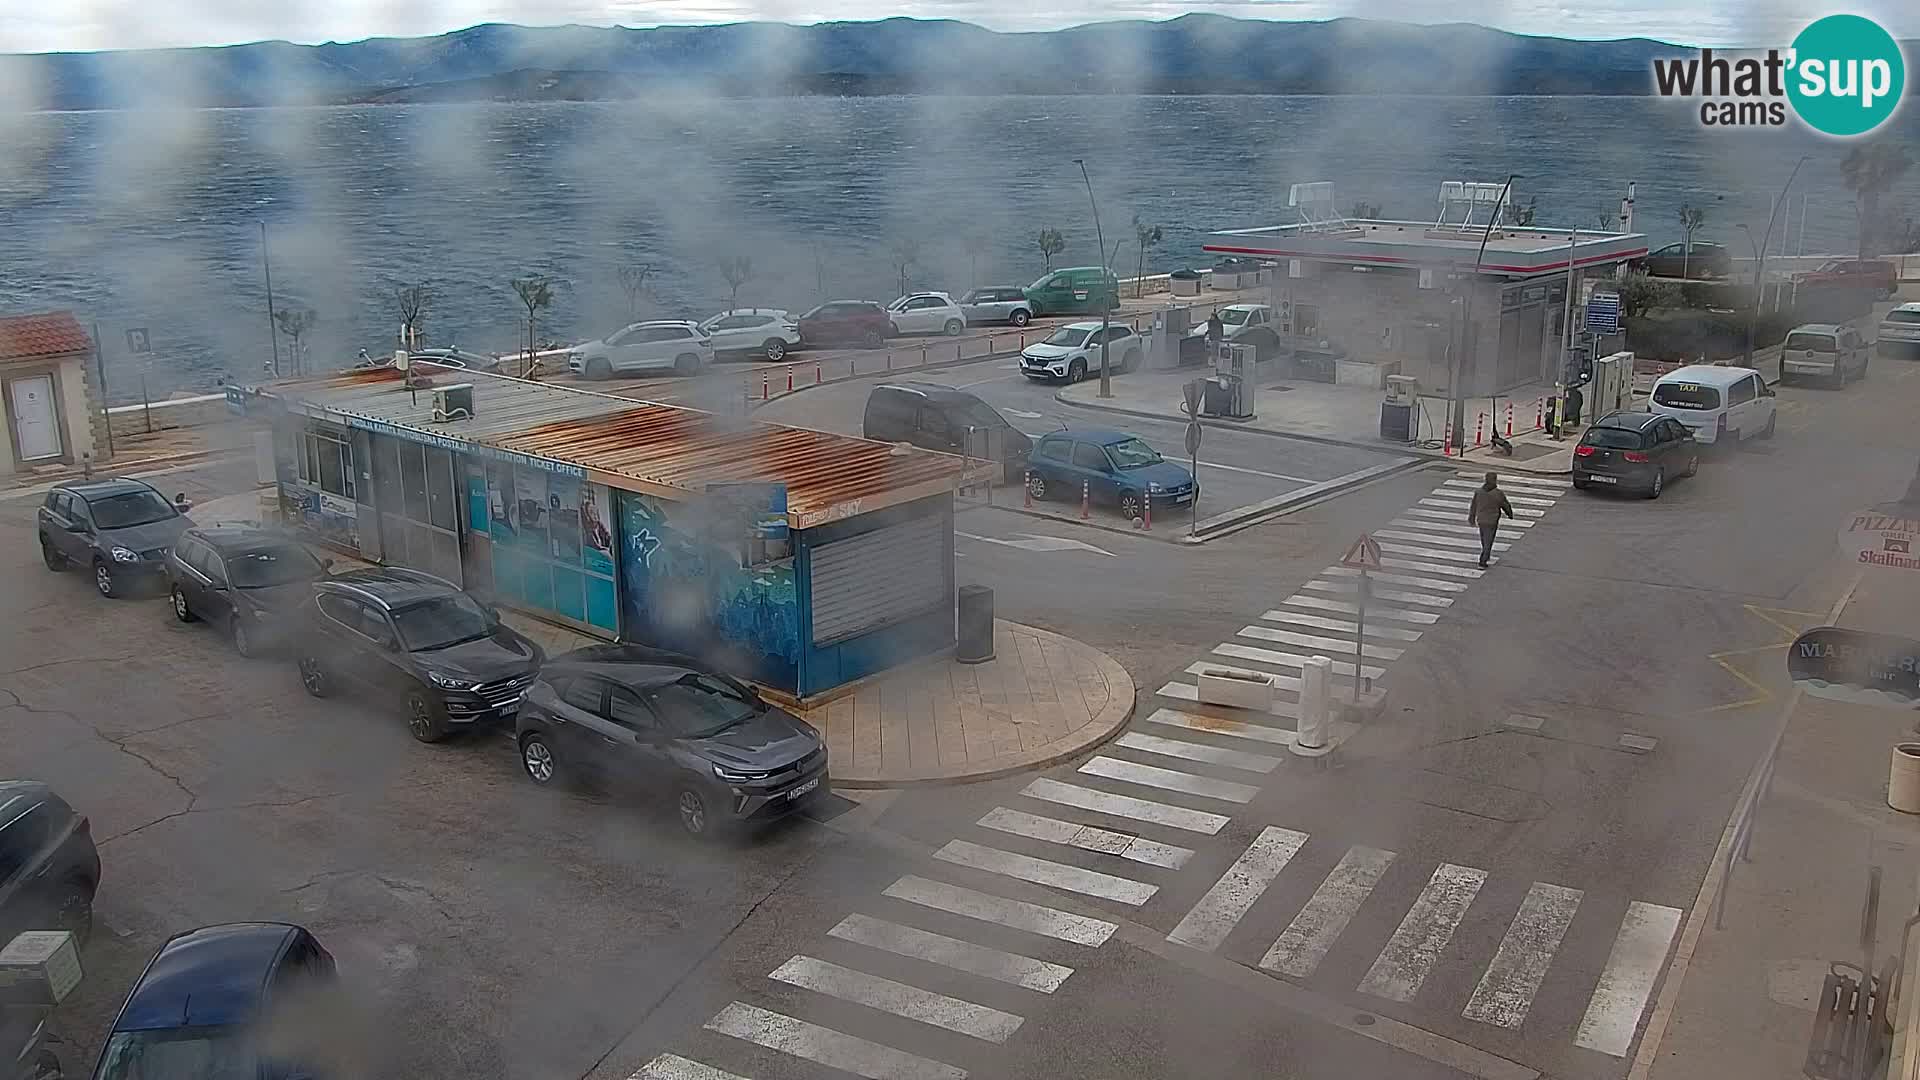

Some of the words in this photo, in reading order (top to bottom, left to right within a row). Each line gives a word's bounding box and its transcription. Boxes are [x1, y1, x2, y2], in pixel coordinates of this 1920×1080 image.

[1679, 384, 1698, 392] TAXI
[529, 457, 555, 472] TICKET
[556, 463, 584, 478] OFFICE
[1848, 515, 1920, 534] PIZZE
